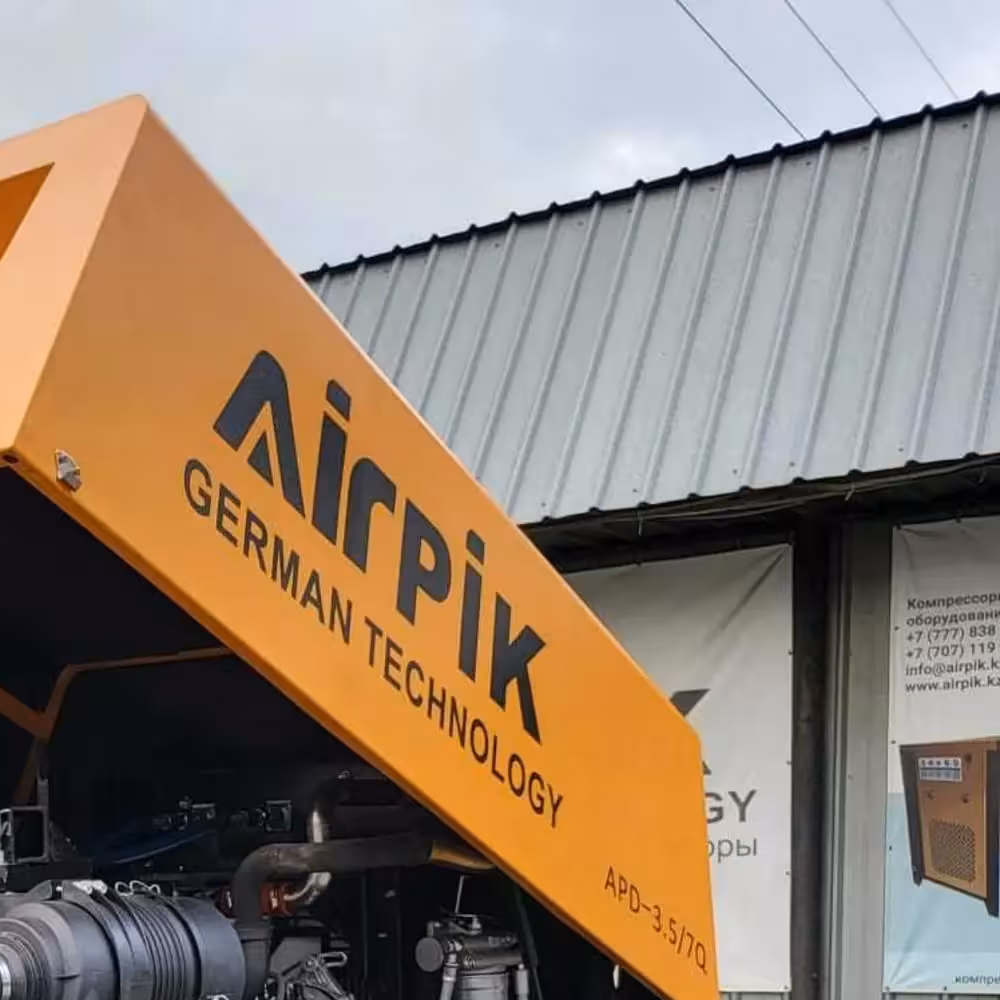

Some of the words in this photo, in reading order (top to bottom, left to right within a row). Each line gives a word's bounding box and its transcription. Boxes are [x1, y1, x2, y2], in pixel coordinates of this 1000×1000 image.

[907, 592, 1000, 610] Компрессор
[184, 458, 353, 646] GERMAN
[364, 615, 564, 829] TECHNOLOGY
[907, 631, 923, 643] +7
[927, 627, 965, 644] (777)
[969, 624, 996, 638] 838
[907, 647, 923, 659] +7
[927, 644, 965, 660] (707)
[970, 641, 996, 655] 119
